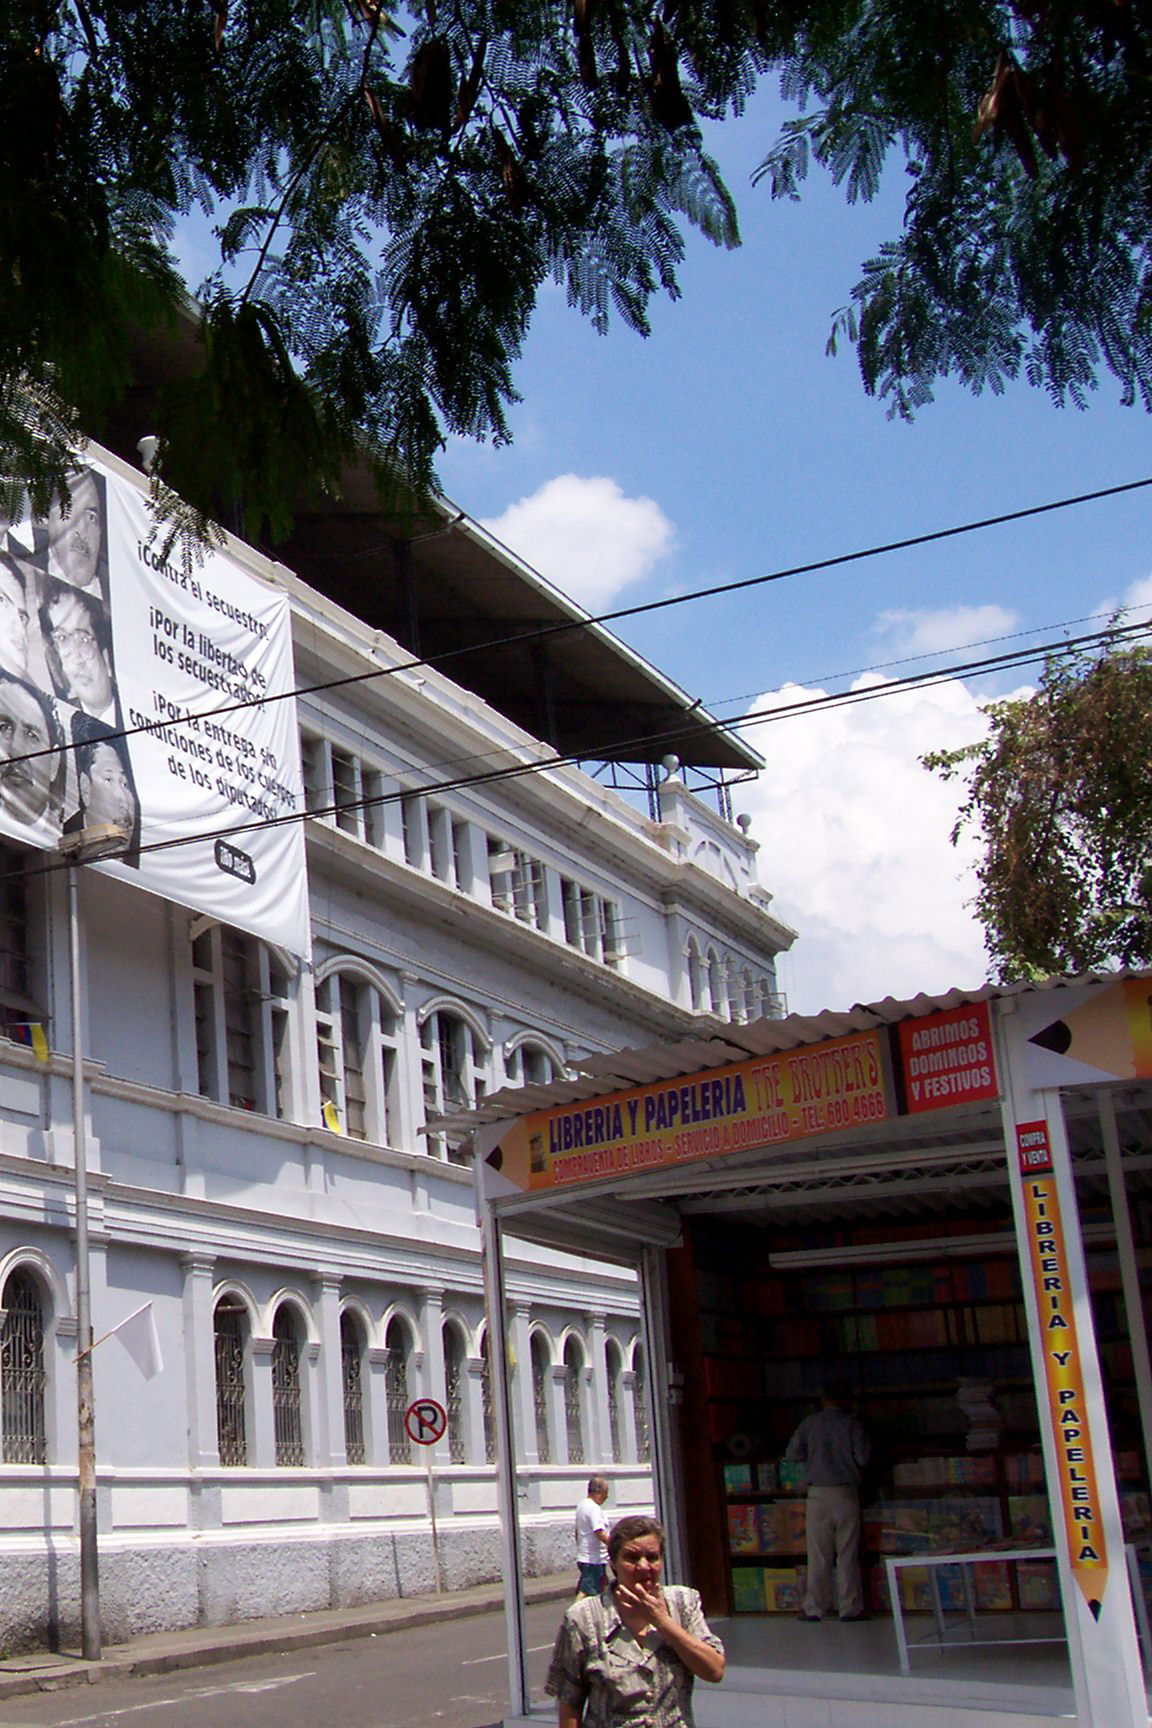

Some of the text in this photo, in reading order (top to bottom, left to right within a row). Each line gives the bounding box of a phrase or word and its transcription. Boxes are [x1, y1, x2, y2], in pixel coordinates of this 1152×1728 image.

[153, 634, 174, 665] los
[183, 624, 195, 650] la
[186, 707, 200, 733] la
[167, 755, 186, 780] de
[189, 763, 213, 791] los
[216, 749, 233, 773] de
[237, 755, 255, 784] los
[912, 1017, 980, 1051] ABRIMOS
[909, 1041, 988, 1077] DOMINGOS
[911, 1066, 992, 1101] Y FESTIVOS
[549, 1102, 624, 1154] LIBRERIA
[627, 1098, 639, 1137] Y
[644, 1072, 747, 1133] PAPELERIA
[1031, 1184, 1099, 1561] LIBRERIA Y PAPELERIA
[417, 1405, 438, 1439] P
